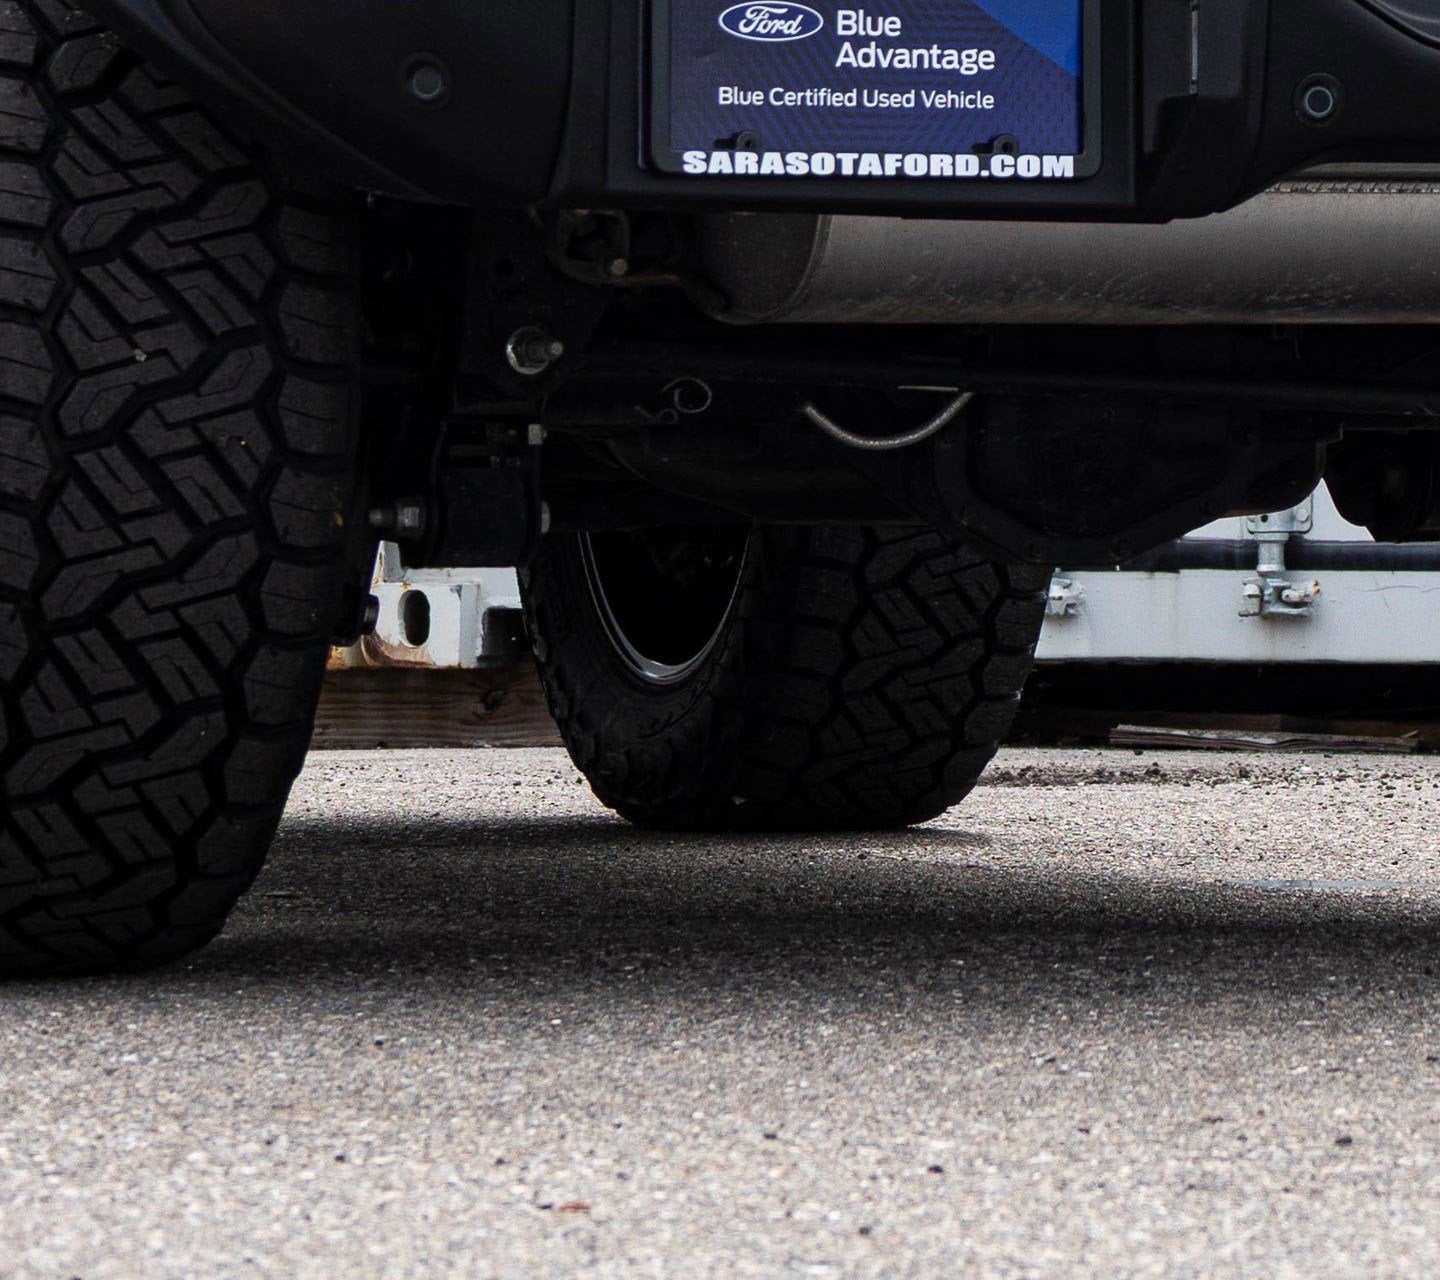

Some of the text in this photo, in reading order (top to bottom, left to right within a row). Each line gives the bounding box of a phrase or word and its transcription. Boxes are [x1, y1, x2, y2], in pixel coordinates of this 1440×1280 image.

[739, 6, 803, 35] Ford
[836, 9, 901, 37] Blue
[835, 41, 996, 75] Advantage
[718, 86, 995, 110] Blue Certified Used Vehicle
[682, 151, 1075, 178] SARASOTAFORD.COM
